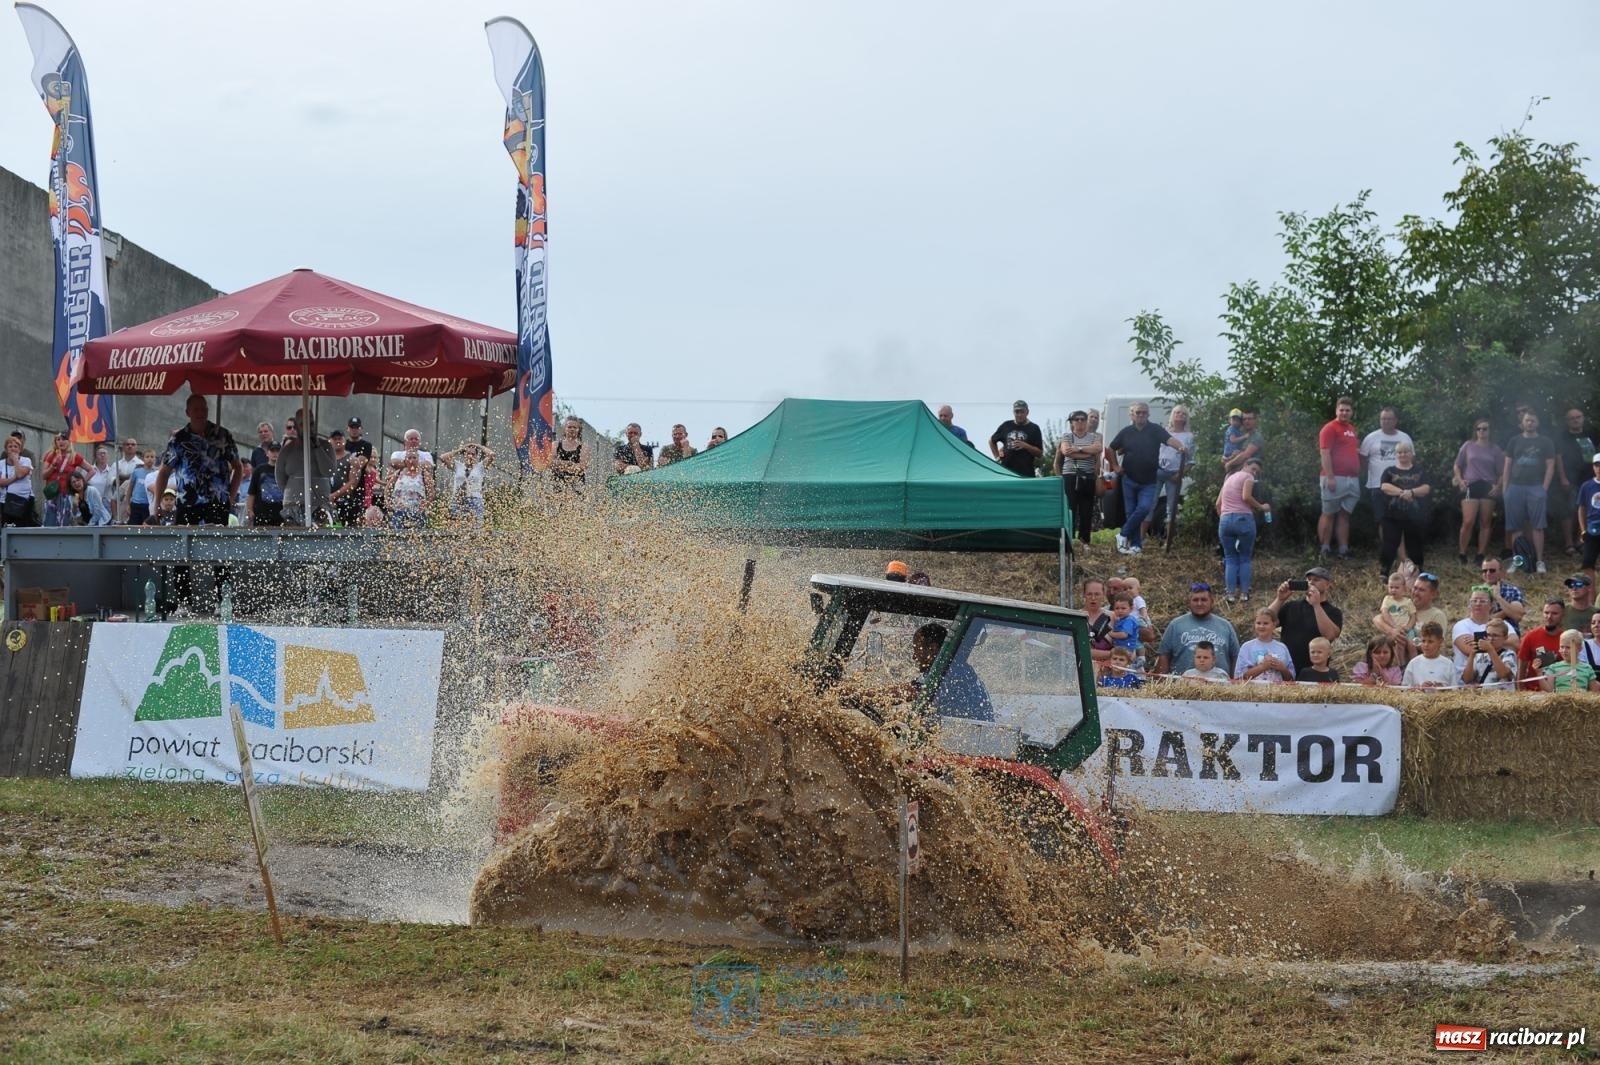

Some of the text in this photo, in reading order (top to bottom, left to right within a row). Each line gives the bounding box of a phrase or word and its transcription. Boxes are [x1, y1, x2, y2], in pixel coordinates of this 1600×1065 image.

[108, 341, 206, 370] RACIBORSKIE
[283, 334, 405, 360] RACIBORSKIE
[128, 733, 375, 766] powiat aciborski
[1105, 727, 1383, 784] RAKTOR
[125, 763, 205, 781] zielona
